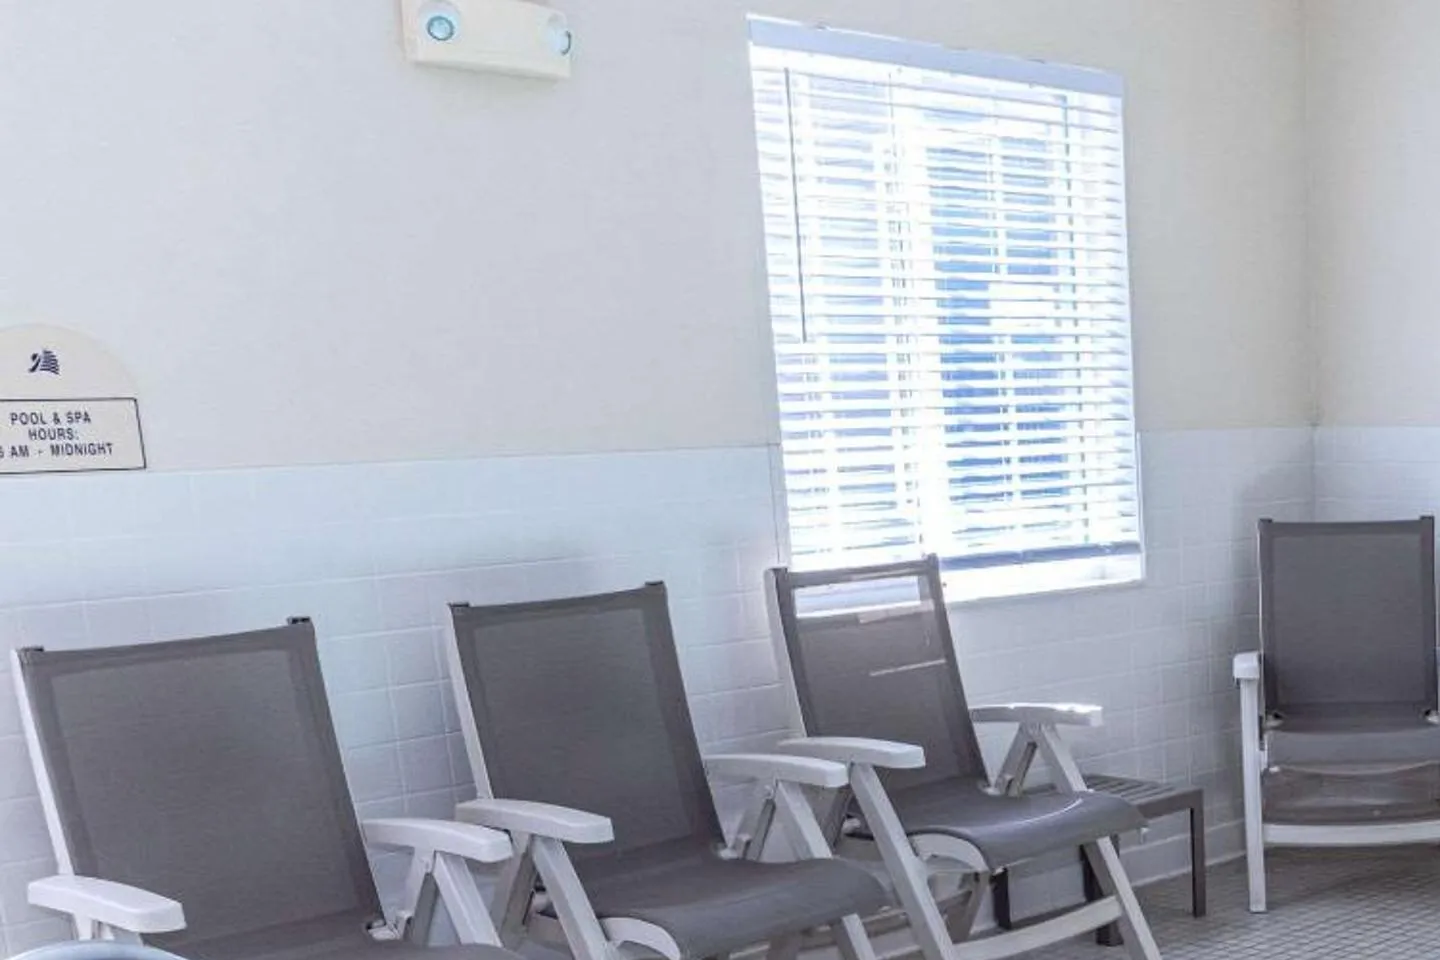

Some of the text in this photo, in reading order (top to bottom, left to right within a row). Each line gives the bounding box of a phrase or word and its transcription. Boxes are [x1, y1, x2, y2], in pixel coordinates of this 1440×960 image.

[10, 411, 92, 426] POOL & SPA
[28, 428, 80, 441] HOURS:
[10, 444, 30, 458] AM
[50, 442, 113, 457] MIDNIGHT
